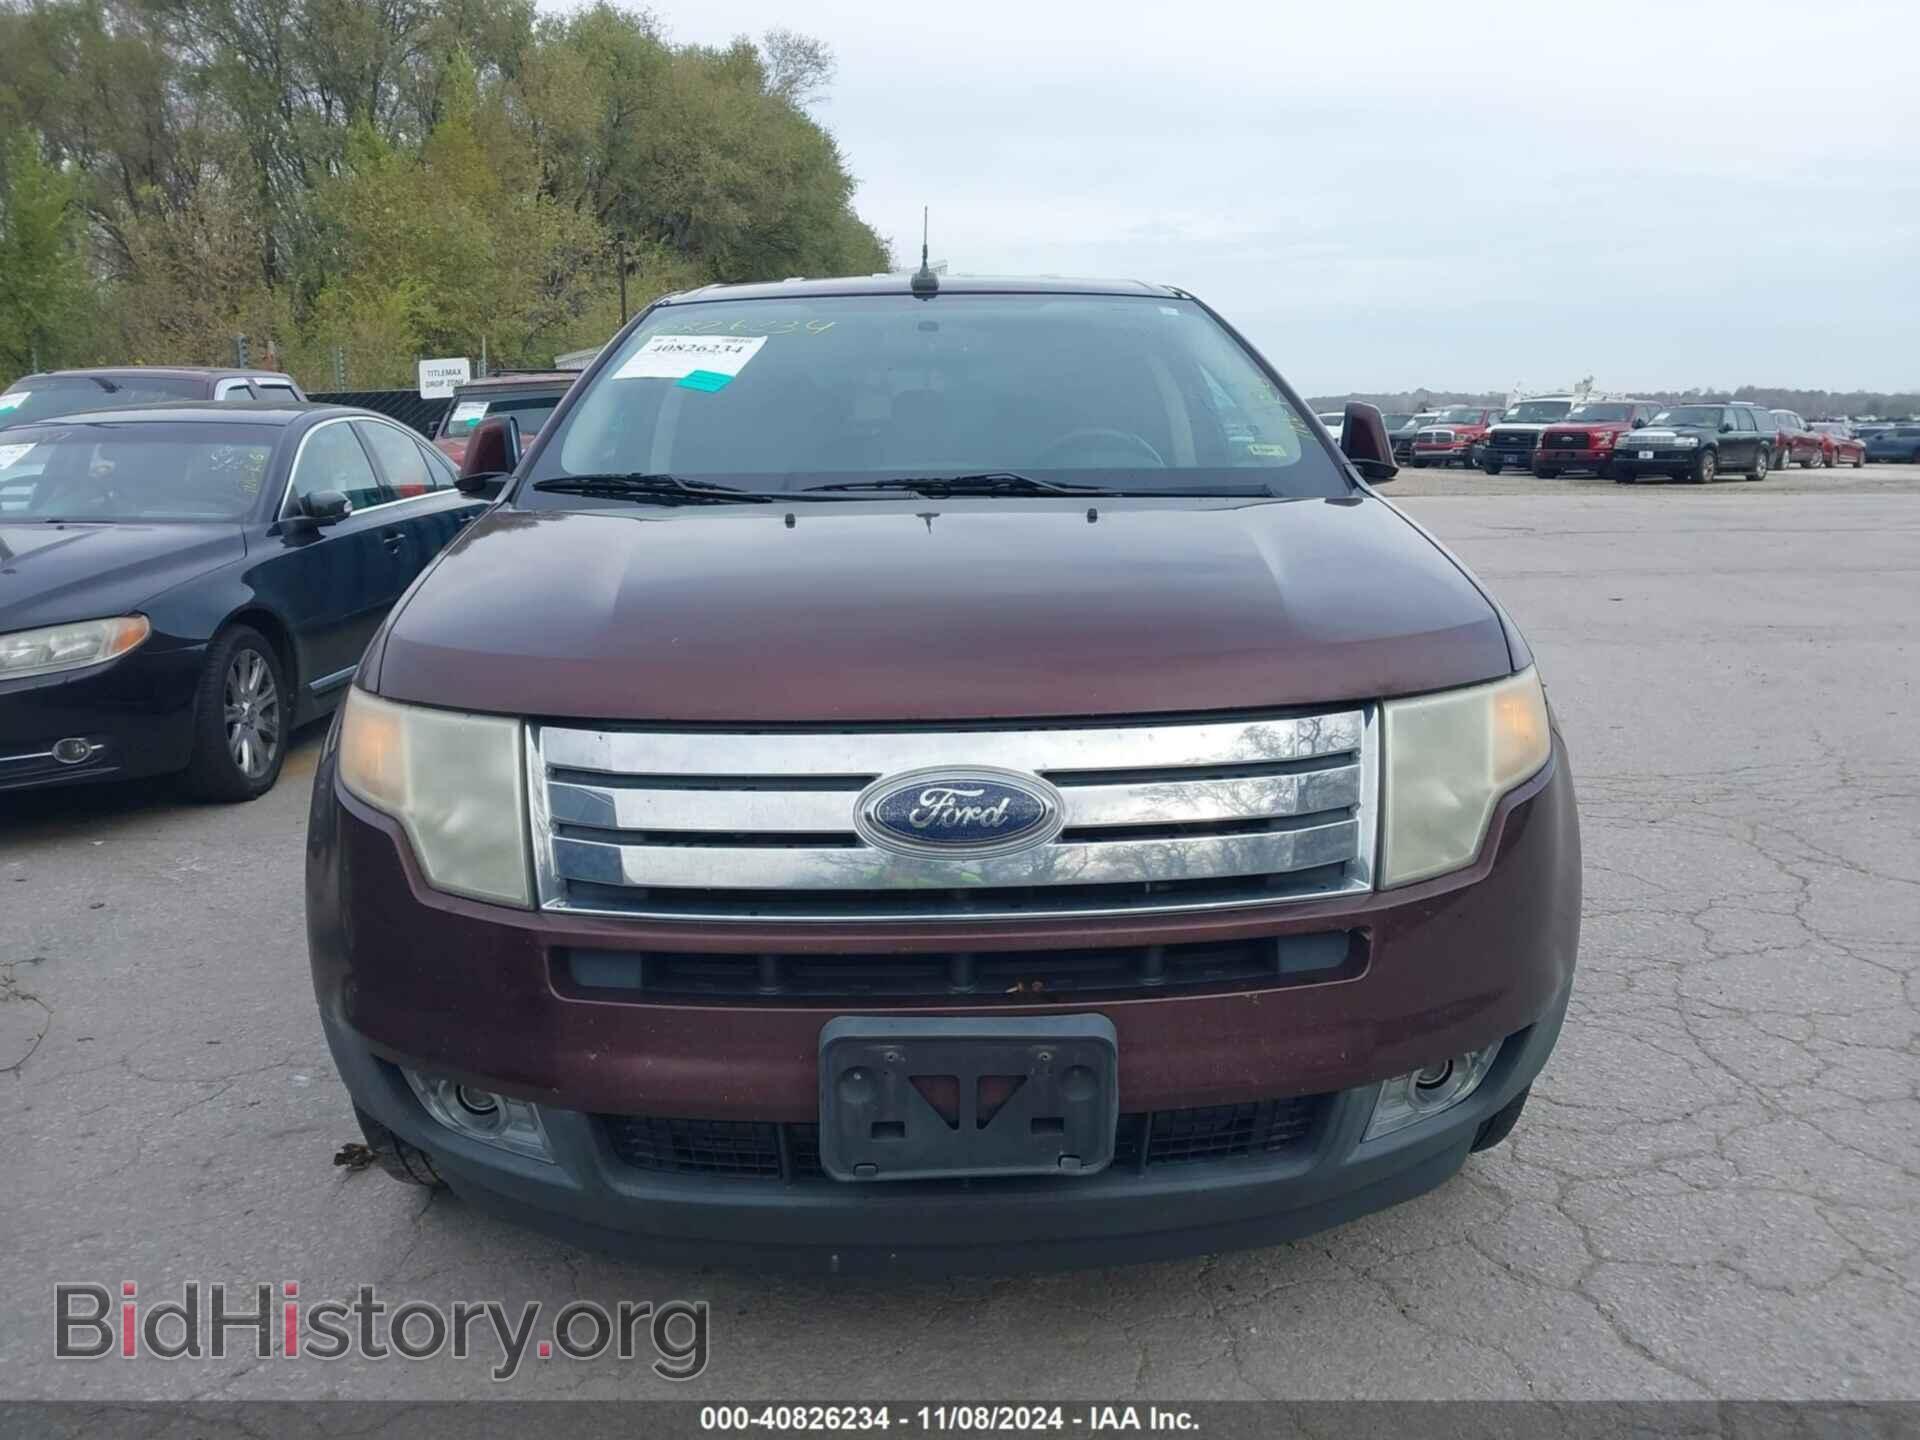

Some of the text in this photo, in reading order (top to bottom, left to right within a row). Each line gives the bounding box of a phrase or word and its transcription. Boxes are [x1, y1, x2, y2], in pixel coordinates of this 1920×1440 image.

[651, 343, 745, 354] 40826234
[427, 368, 462, 377] TITLEMAX
[909, 787, 1011, 828] Ford
